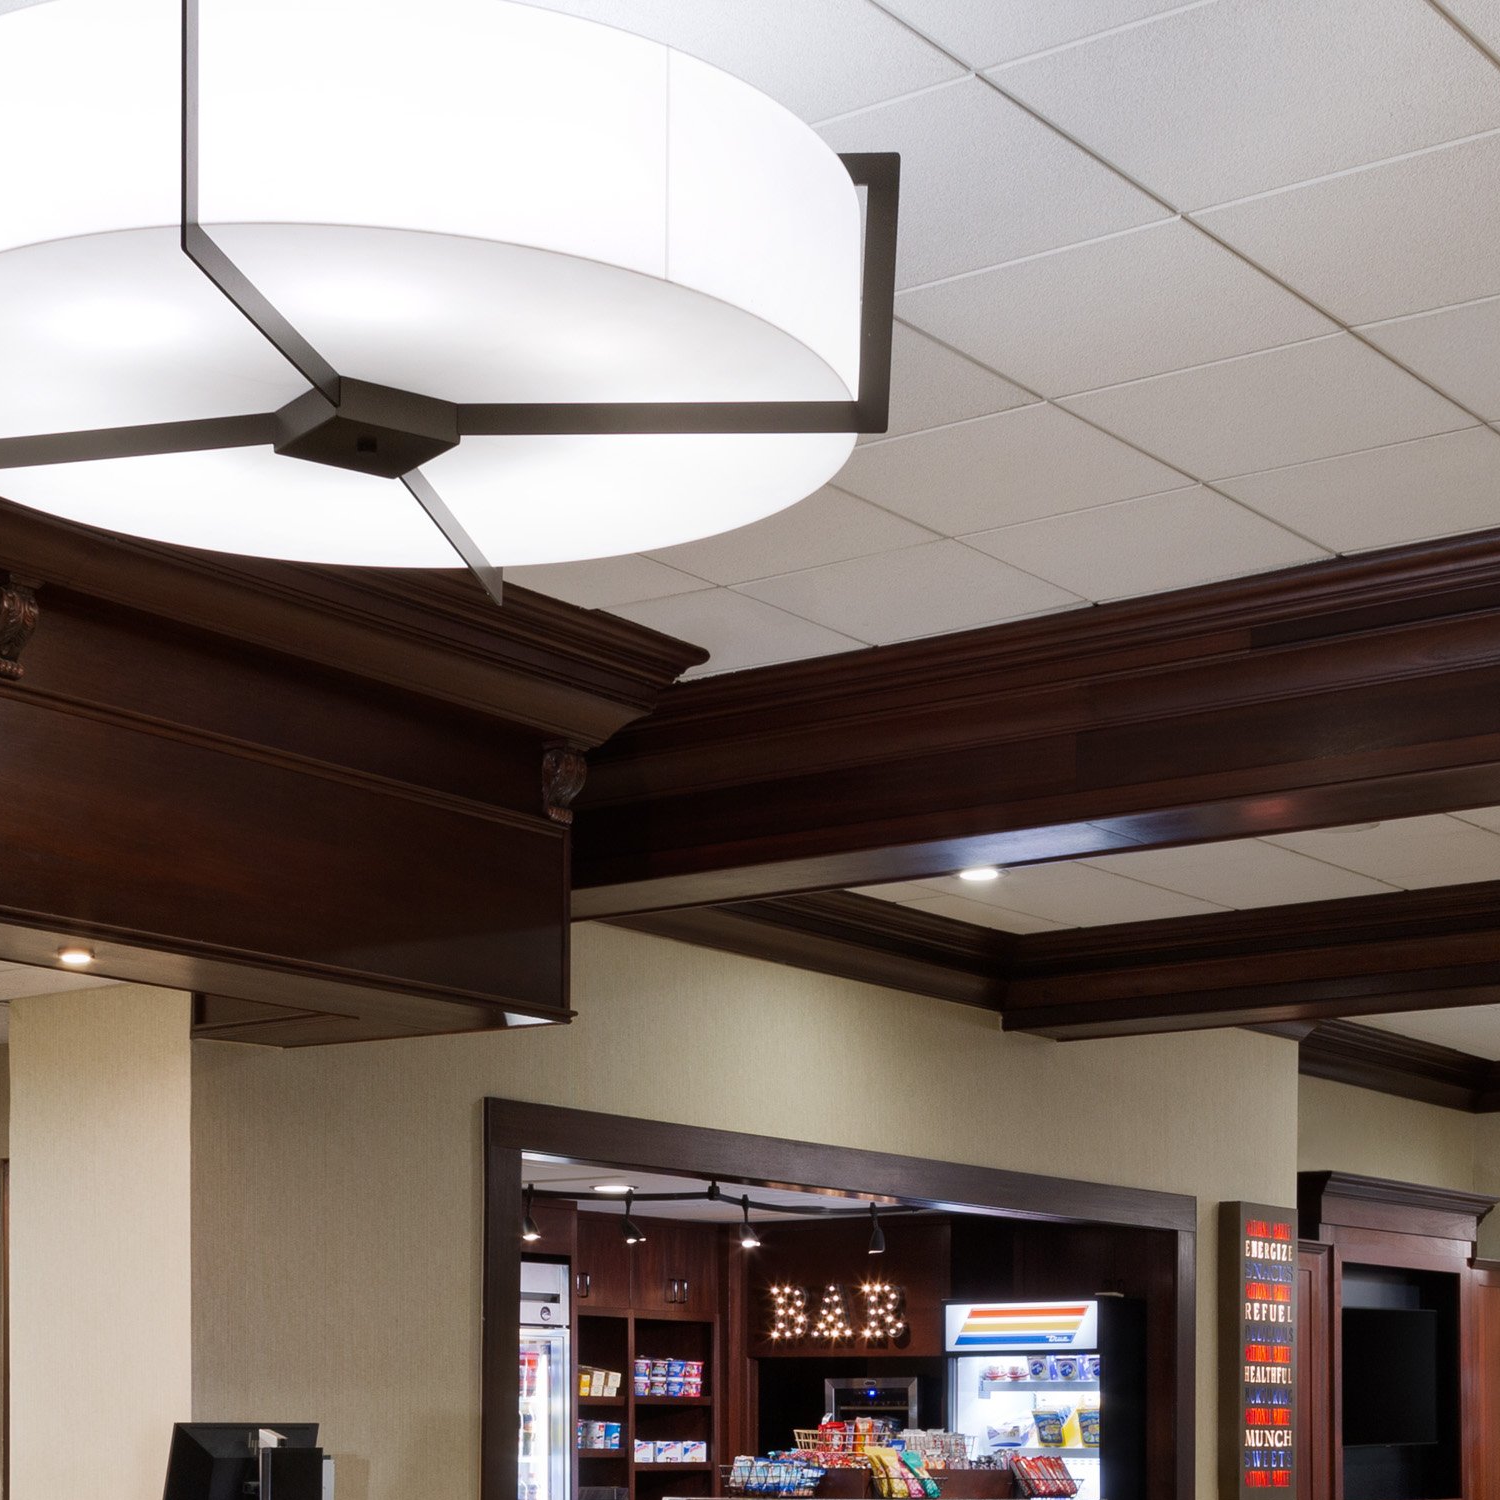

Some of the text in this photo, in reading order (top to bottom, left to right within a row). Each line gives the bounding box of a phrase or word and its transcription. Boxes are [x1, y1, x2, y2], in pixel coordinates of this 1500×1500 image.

[1245, 1240, 1293, 1262] ENERGIZE
[1244, 1261, 1294, 1283] SNACKS
[768, 1283, 904, 1338] BAR
[1244, 1302, 1293, 1323] REFUEL
[1244, 1365, 1293, 1384] HEALTHFUL
[1244, 1429, 1293, 1448] MUNCH
[1244, 1450, 1293, 1468] SWEETS
